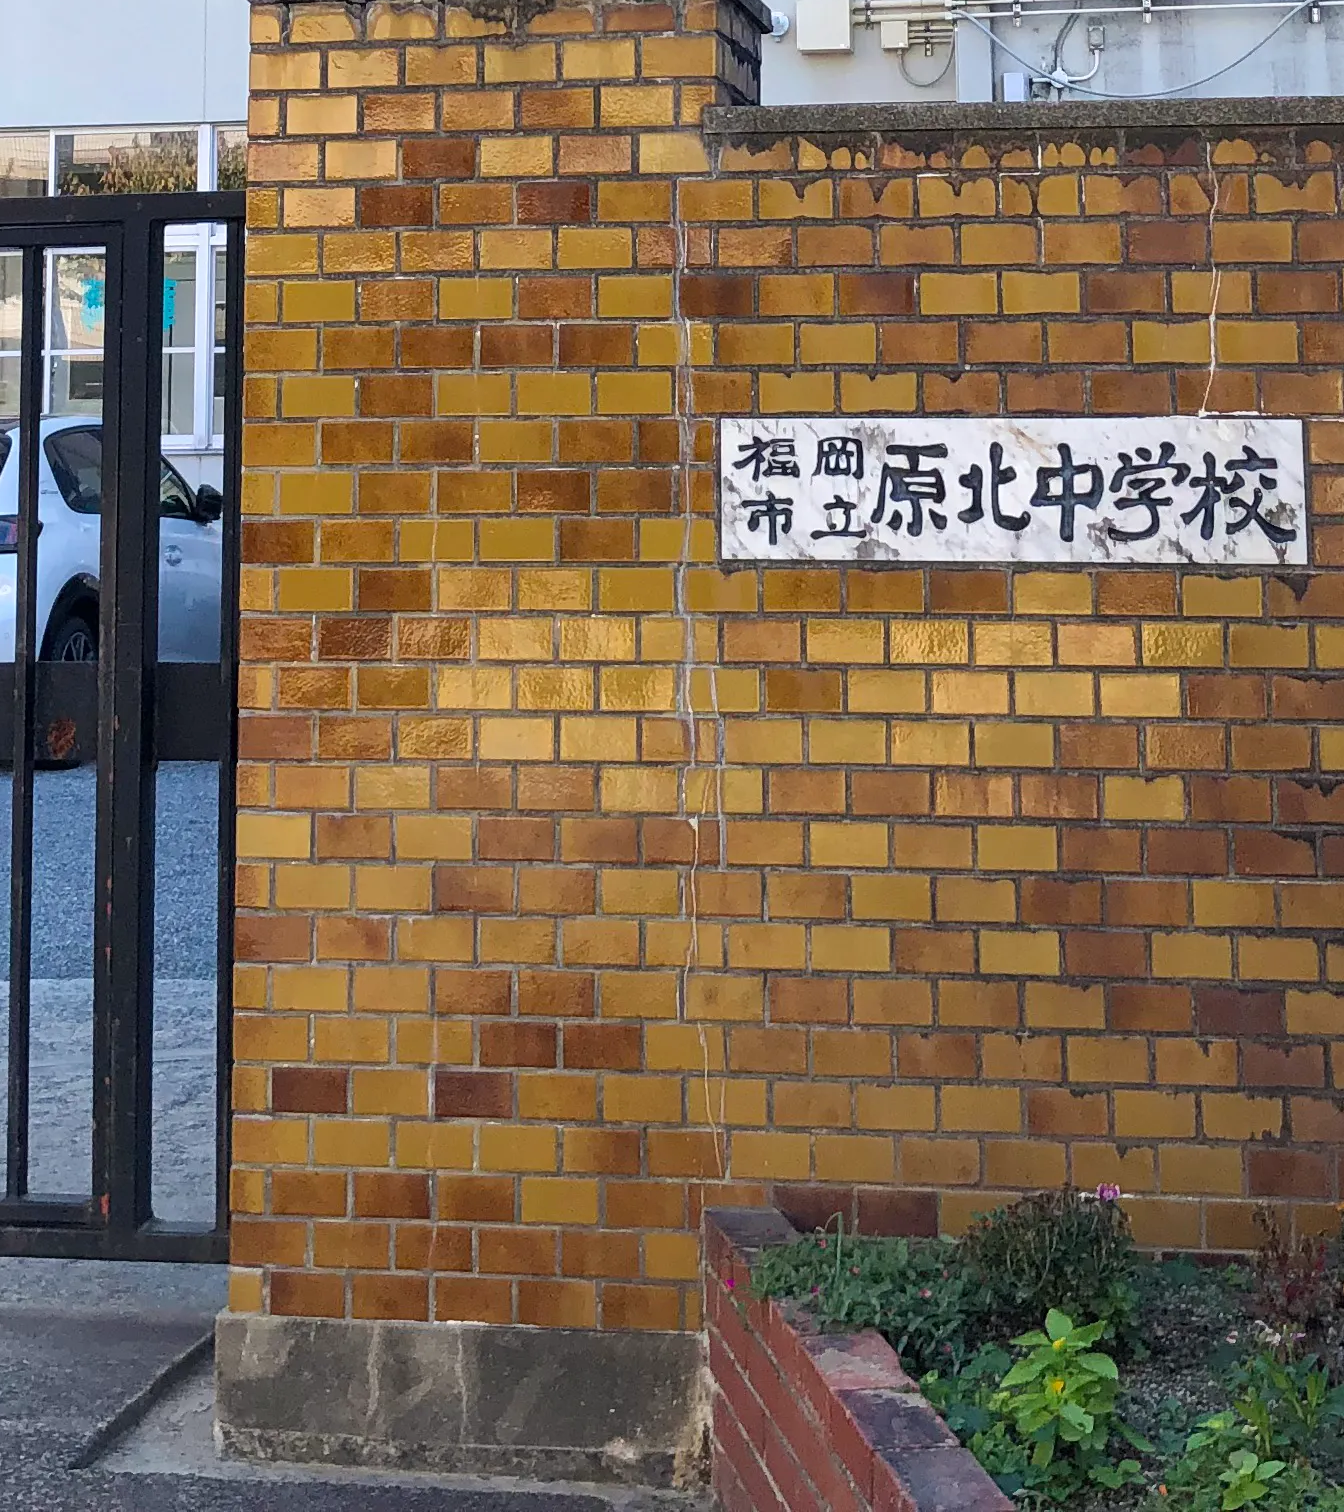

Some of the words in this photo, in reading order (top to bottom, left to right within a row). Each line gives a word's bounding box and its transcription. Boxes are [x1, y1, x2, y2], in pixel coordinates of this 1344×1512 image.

[732, 436, 864, 481] 福岡
[742, 490, 868, 546] 市立
[871, 441, 1297, 543] 原北中学校
